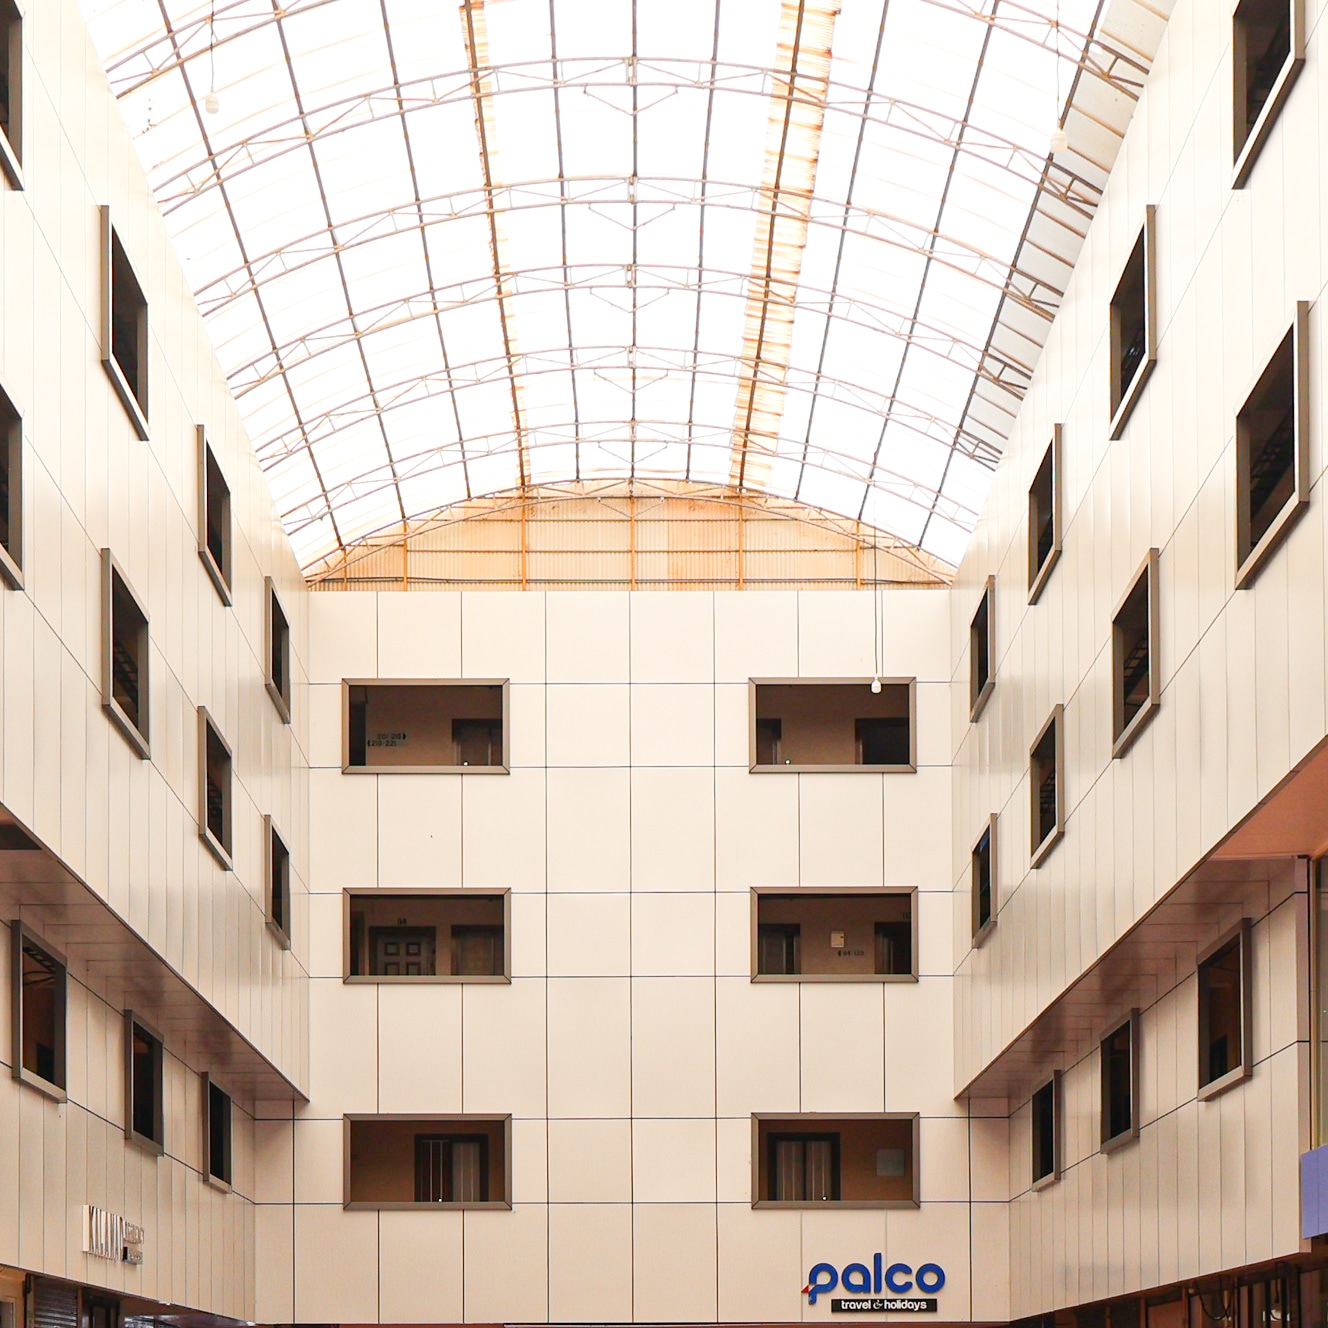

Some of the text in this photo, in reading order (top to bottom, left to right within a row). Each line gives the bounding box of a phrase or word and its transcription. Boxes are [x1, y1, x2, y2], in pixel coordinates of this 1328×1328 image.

[806, 1252, 946, 1306] palco
[841, 1299, 872, 1310] travel
[884, 1299, 927, 1312] holidays
